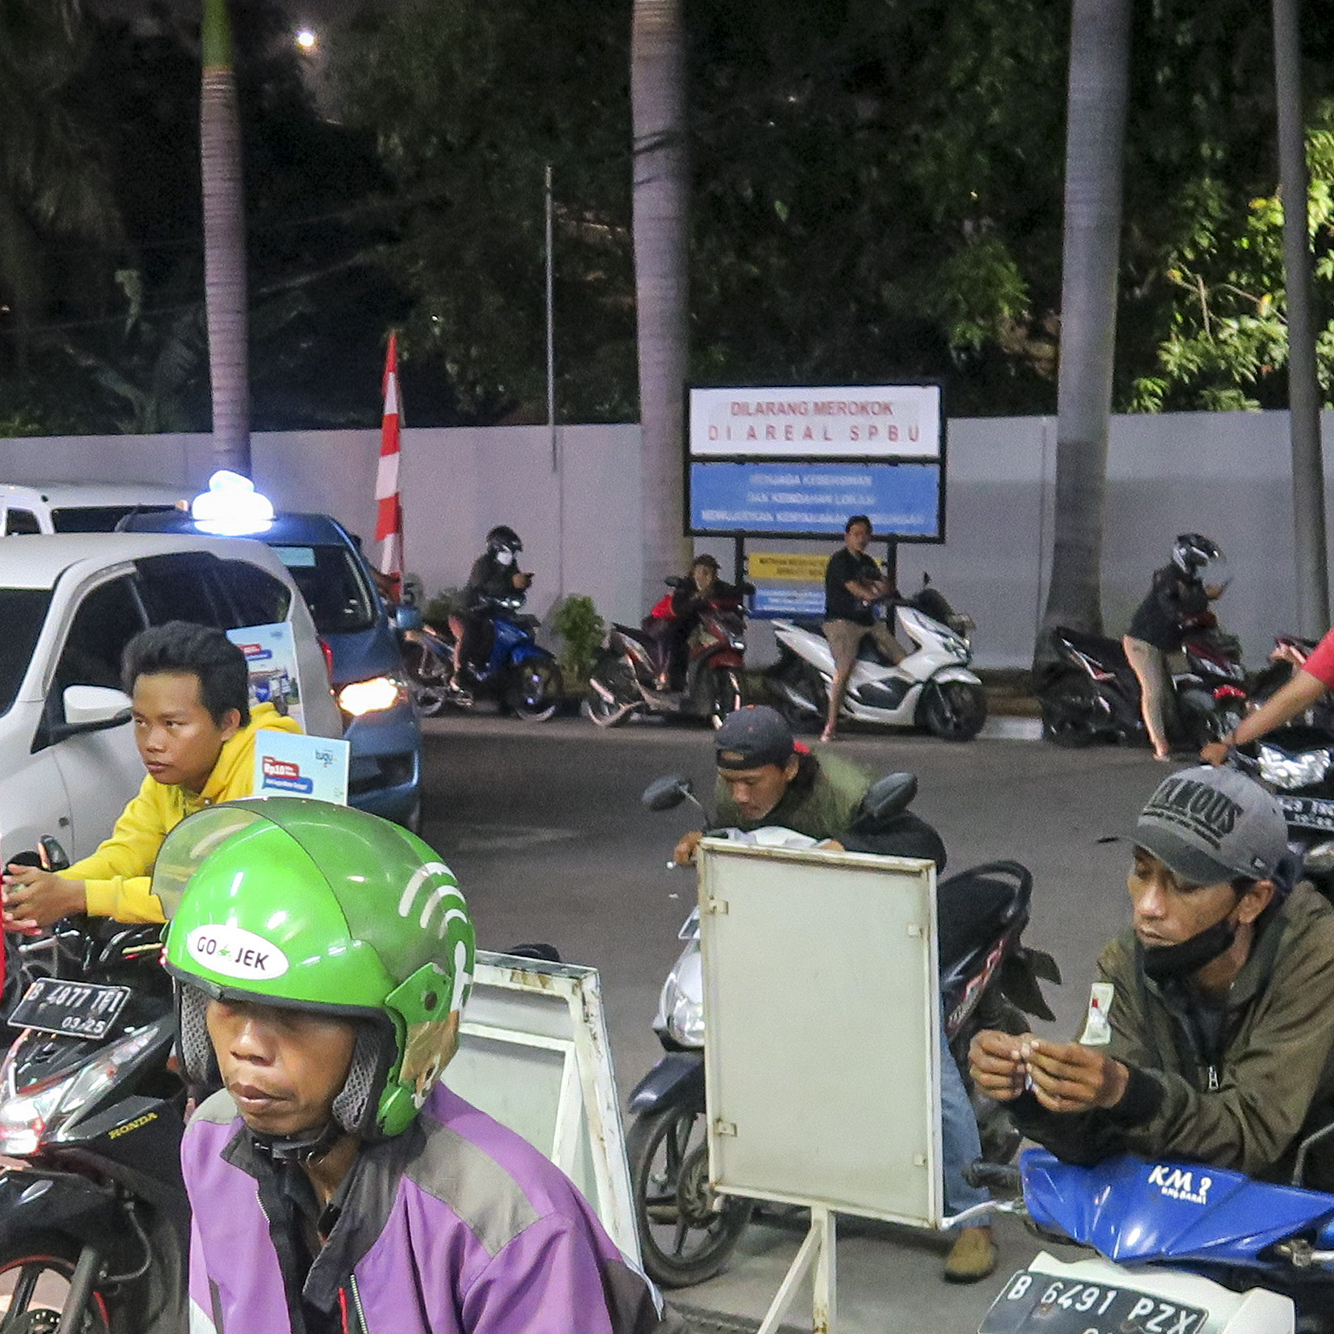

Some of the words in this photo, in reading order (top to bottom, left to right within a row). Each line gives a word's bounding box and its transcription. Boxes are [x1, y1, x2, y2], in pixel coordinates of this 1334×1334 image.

[730, 400, 809, 417] DILARANG
[813, 400, 894, 416] MEROKOK
[708, 424, 732, 442] DI
[746, 424, 833, 442] AREAL
[849, 424, 921, 443] SPBU
[197, 936, 217, 955] GO
[234, 947, 270, 971] JEK
[27, 982, 46, 1001] B
[107, 1112, 159, 1140] HONDA
[1007, 1275, 1033, 1300] B
[1040, 1281, 1118, 1317] 6491
